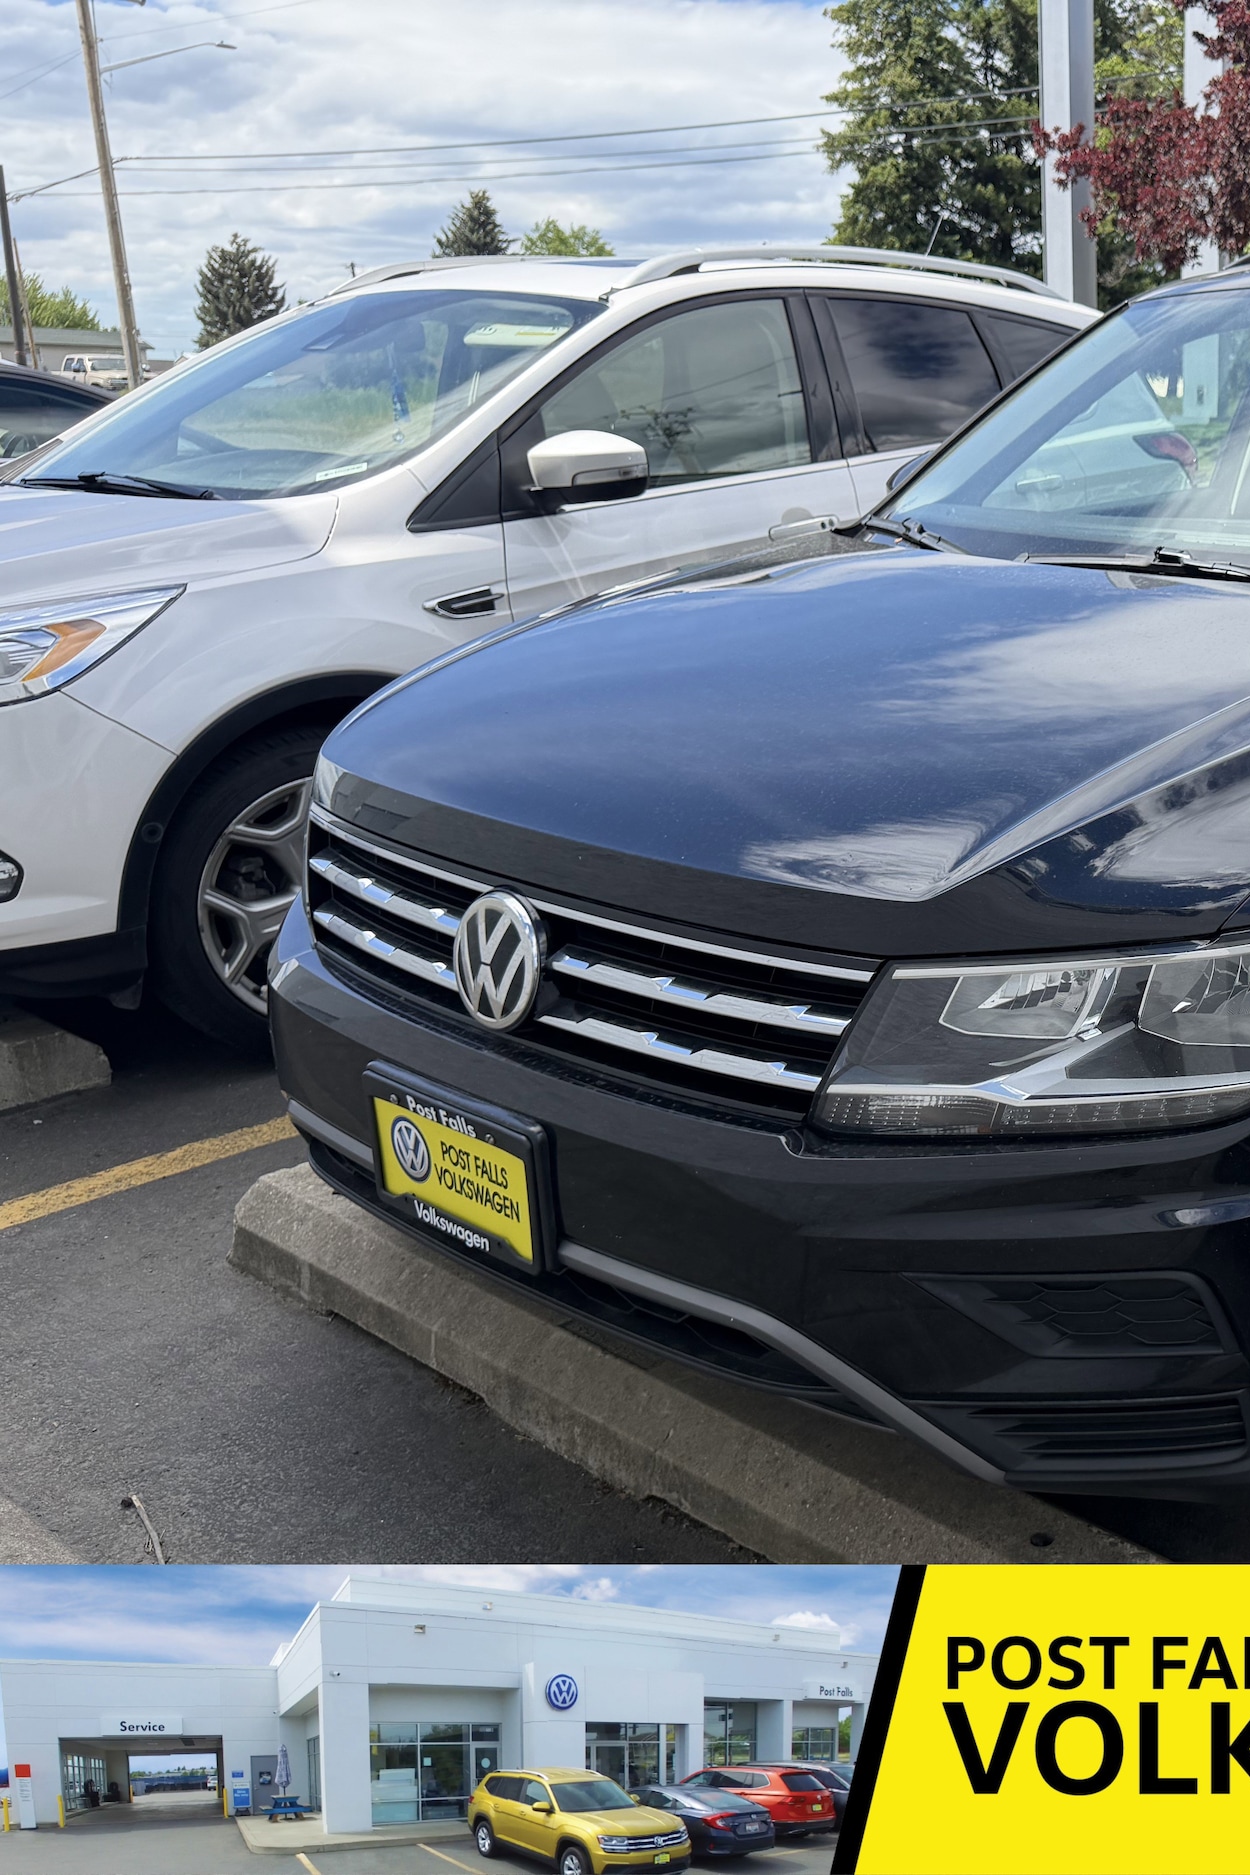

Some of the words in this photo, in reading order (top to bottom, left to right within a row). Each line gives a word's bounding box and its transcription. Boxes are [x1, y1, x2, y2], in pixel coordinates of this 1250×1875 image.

[406, 1094, 437, 1122] Post
[439, 1109, 476, 1138] Falls
[440, 1140, 471, 1173] POST
[474, 1155, 508, 1190] FALLS
[434, 1163, 520, 1223] VOLKSWAGEN
[414, 1200, 490, 1252] Volkswagen
